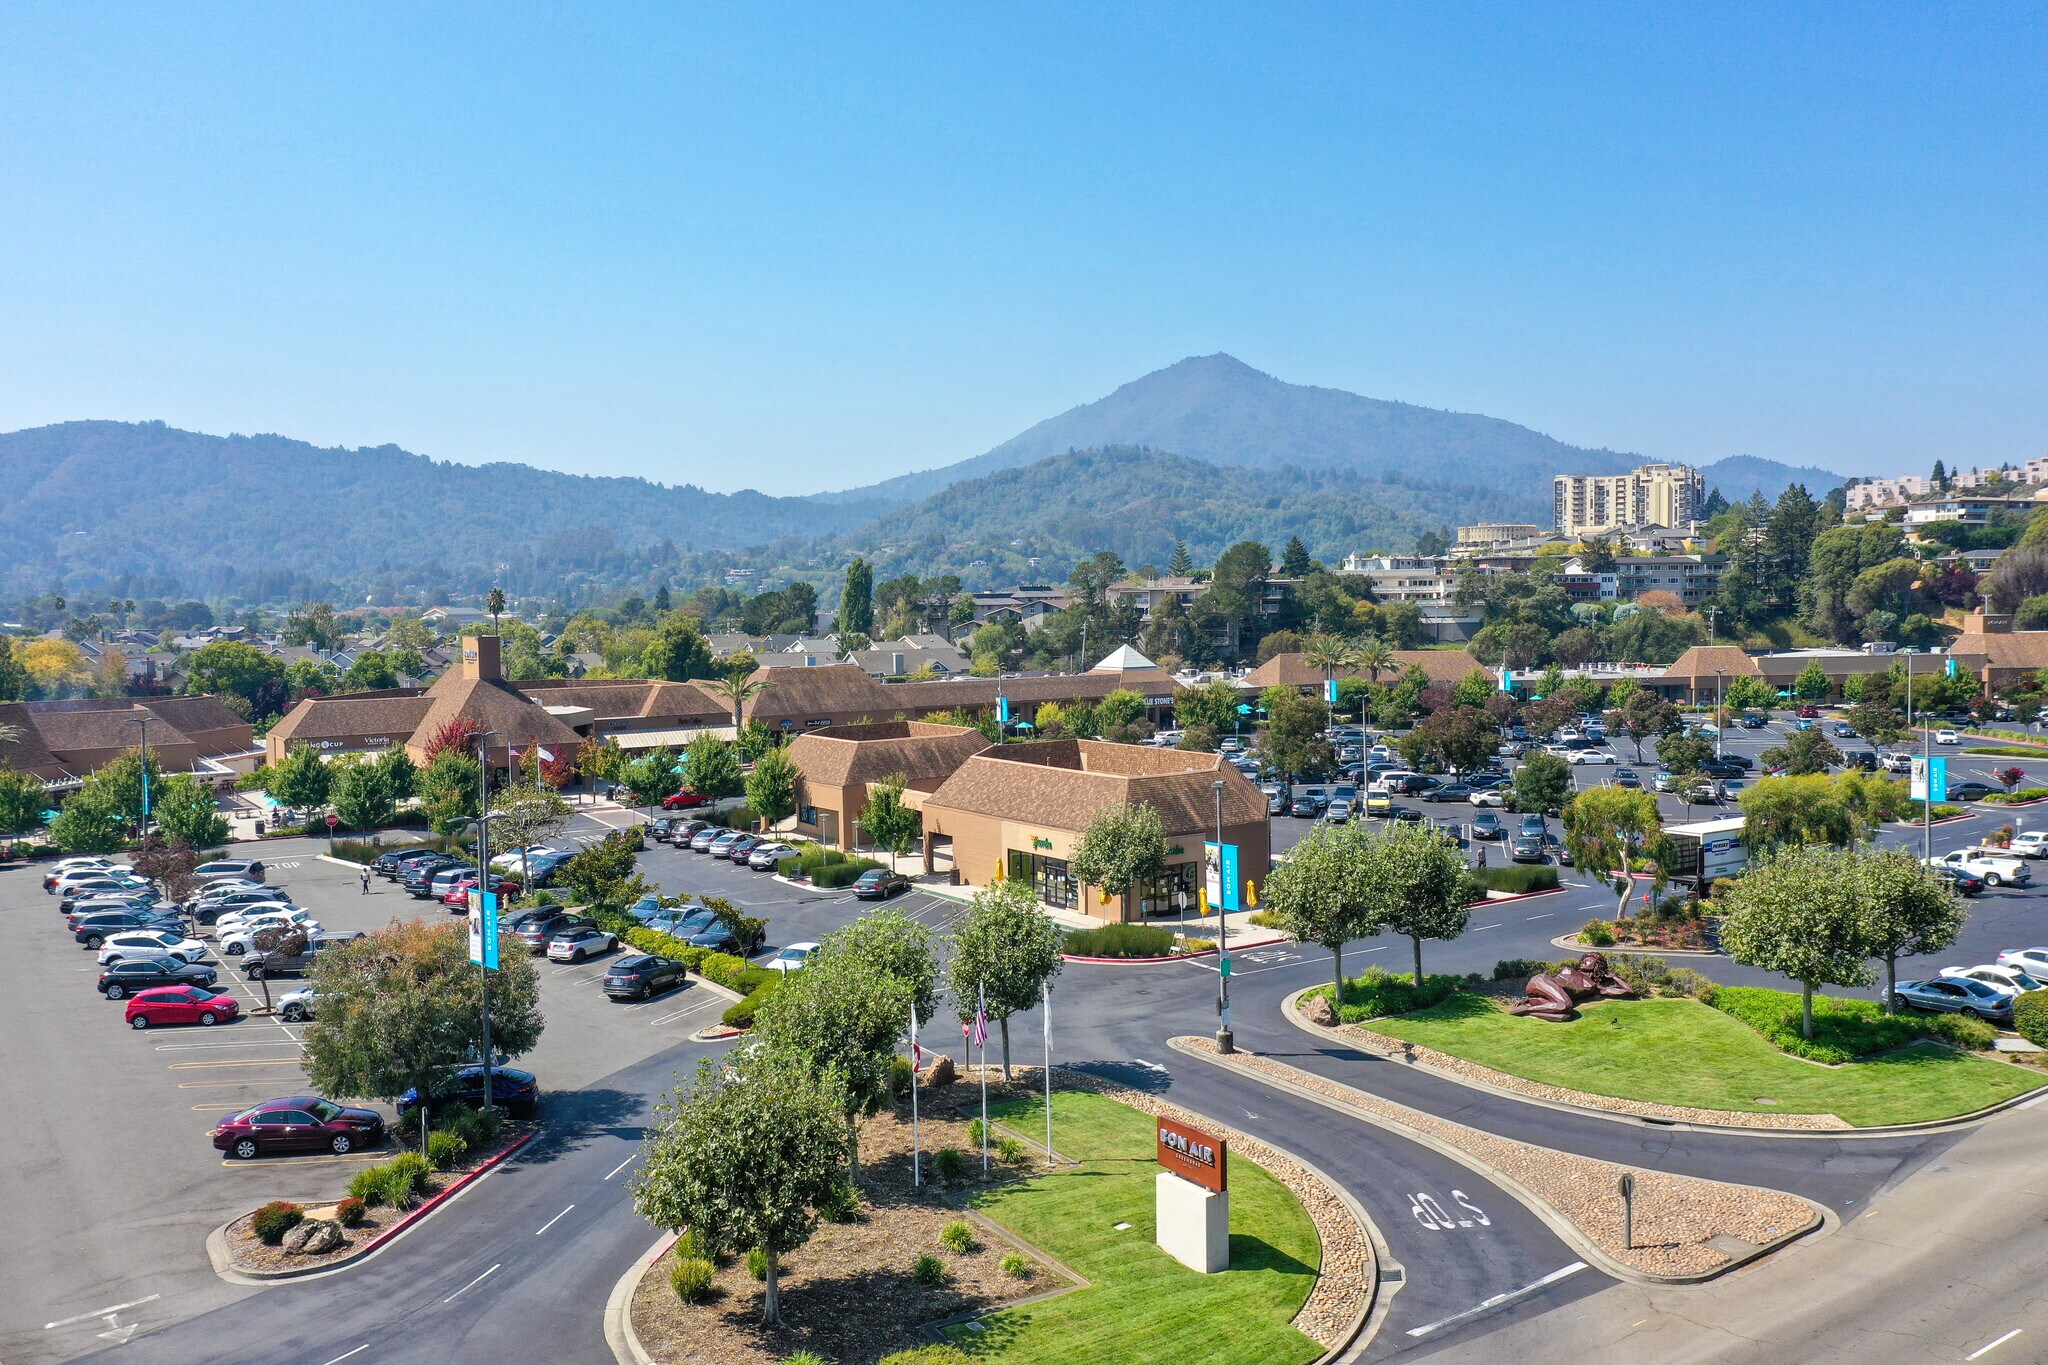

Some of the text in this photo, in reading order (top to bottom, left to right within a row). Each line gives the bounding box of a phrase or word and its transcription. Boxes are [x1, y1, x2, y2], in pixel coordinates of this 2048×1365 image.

[1154, 696, 1174, 705] STONE'S
[364, 736, 390, 744] Victoria
[1160, 1128, 1213, 1162] BON AIR
[1406, 1189, 1491, 1231] STOP
